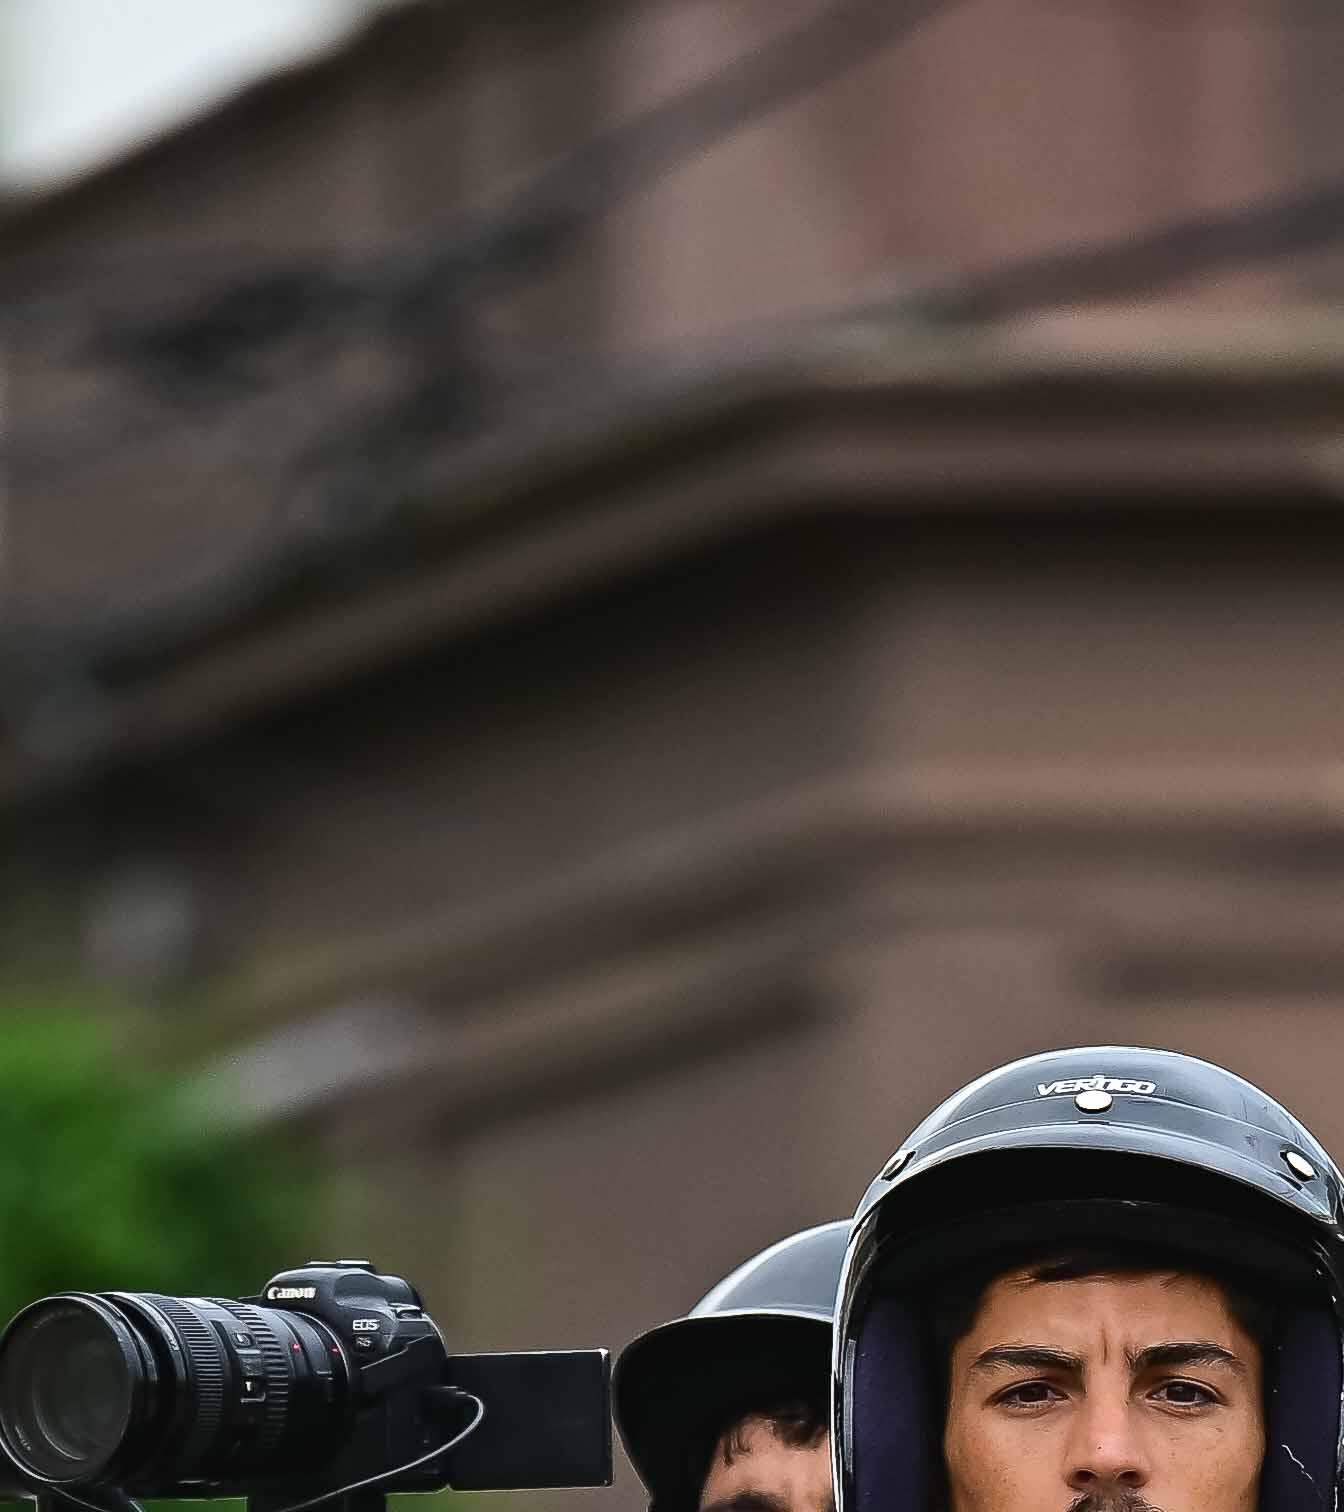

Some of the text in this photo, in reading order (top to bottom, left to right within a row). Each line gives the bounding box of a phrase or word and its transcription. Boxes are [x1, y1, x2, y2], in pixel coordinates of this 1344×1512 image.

[1036, 1075, 1156, 1096] VERTIGO
[267, 1287, 317, 1300] Canon
[352, 1318, 381, 1331] EOS
